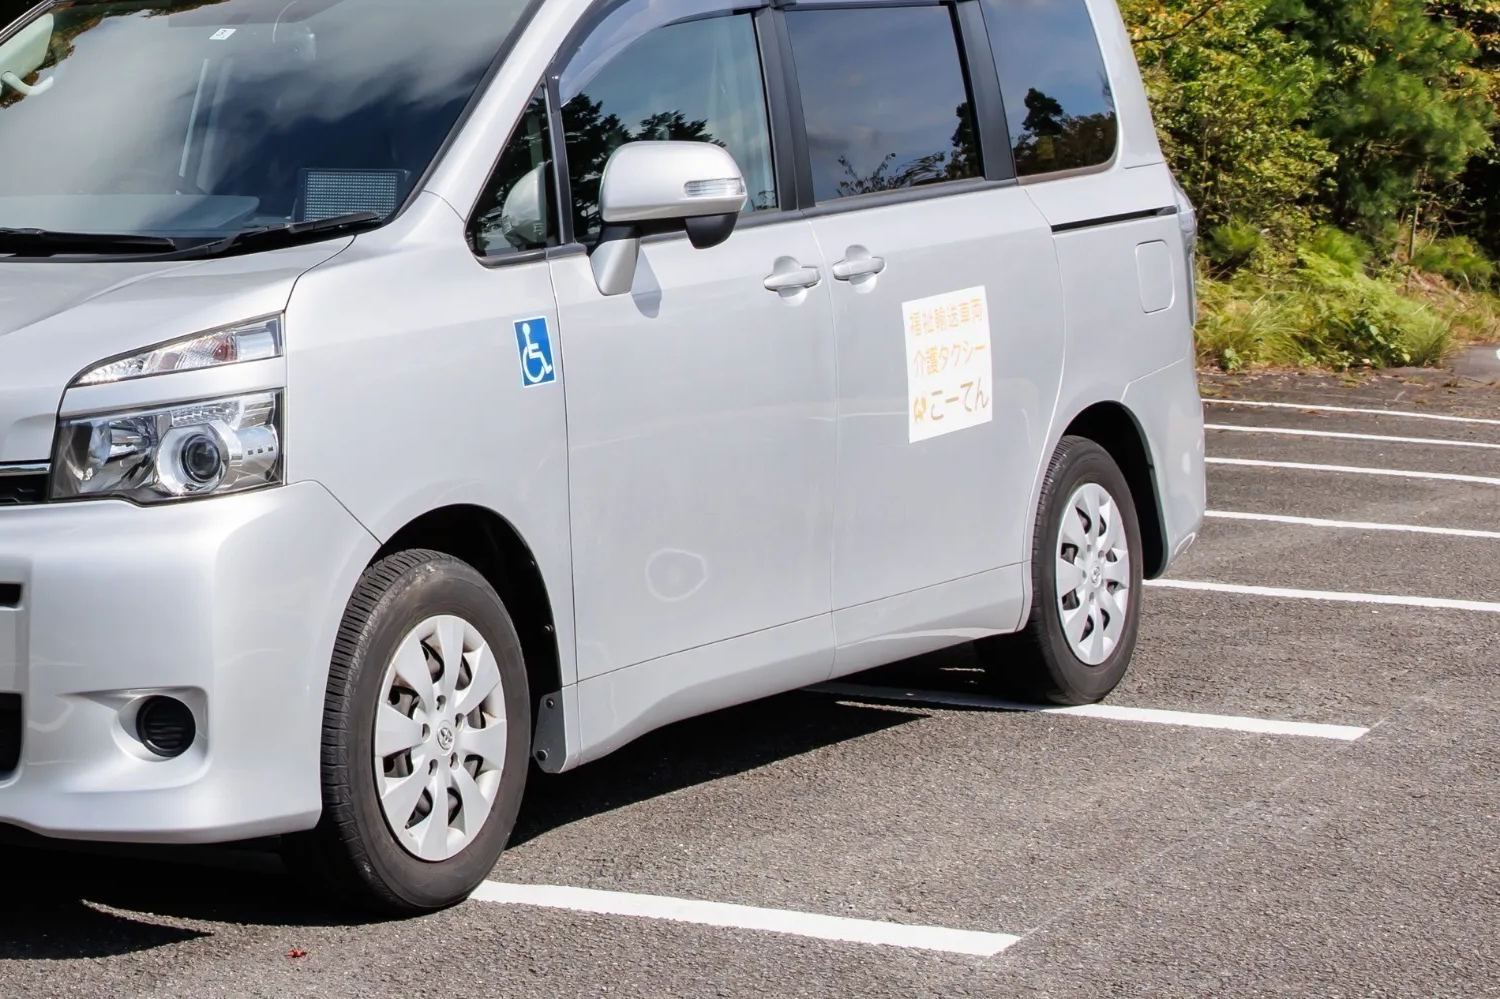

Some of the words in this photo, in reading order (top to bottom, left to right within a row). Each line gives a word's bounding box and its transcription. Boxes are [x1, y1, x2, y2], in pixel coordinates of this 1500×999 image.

[913, 340, 986, 378] 介護タクシー
[930, 376, 990, 421] こーてん
